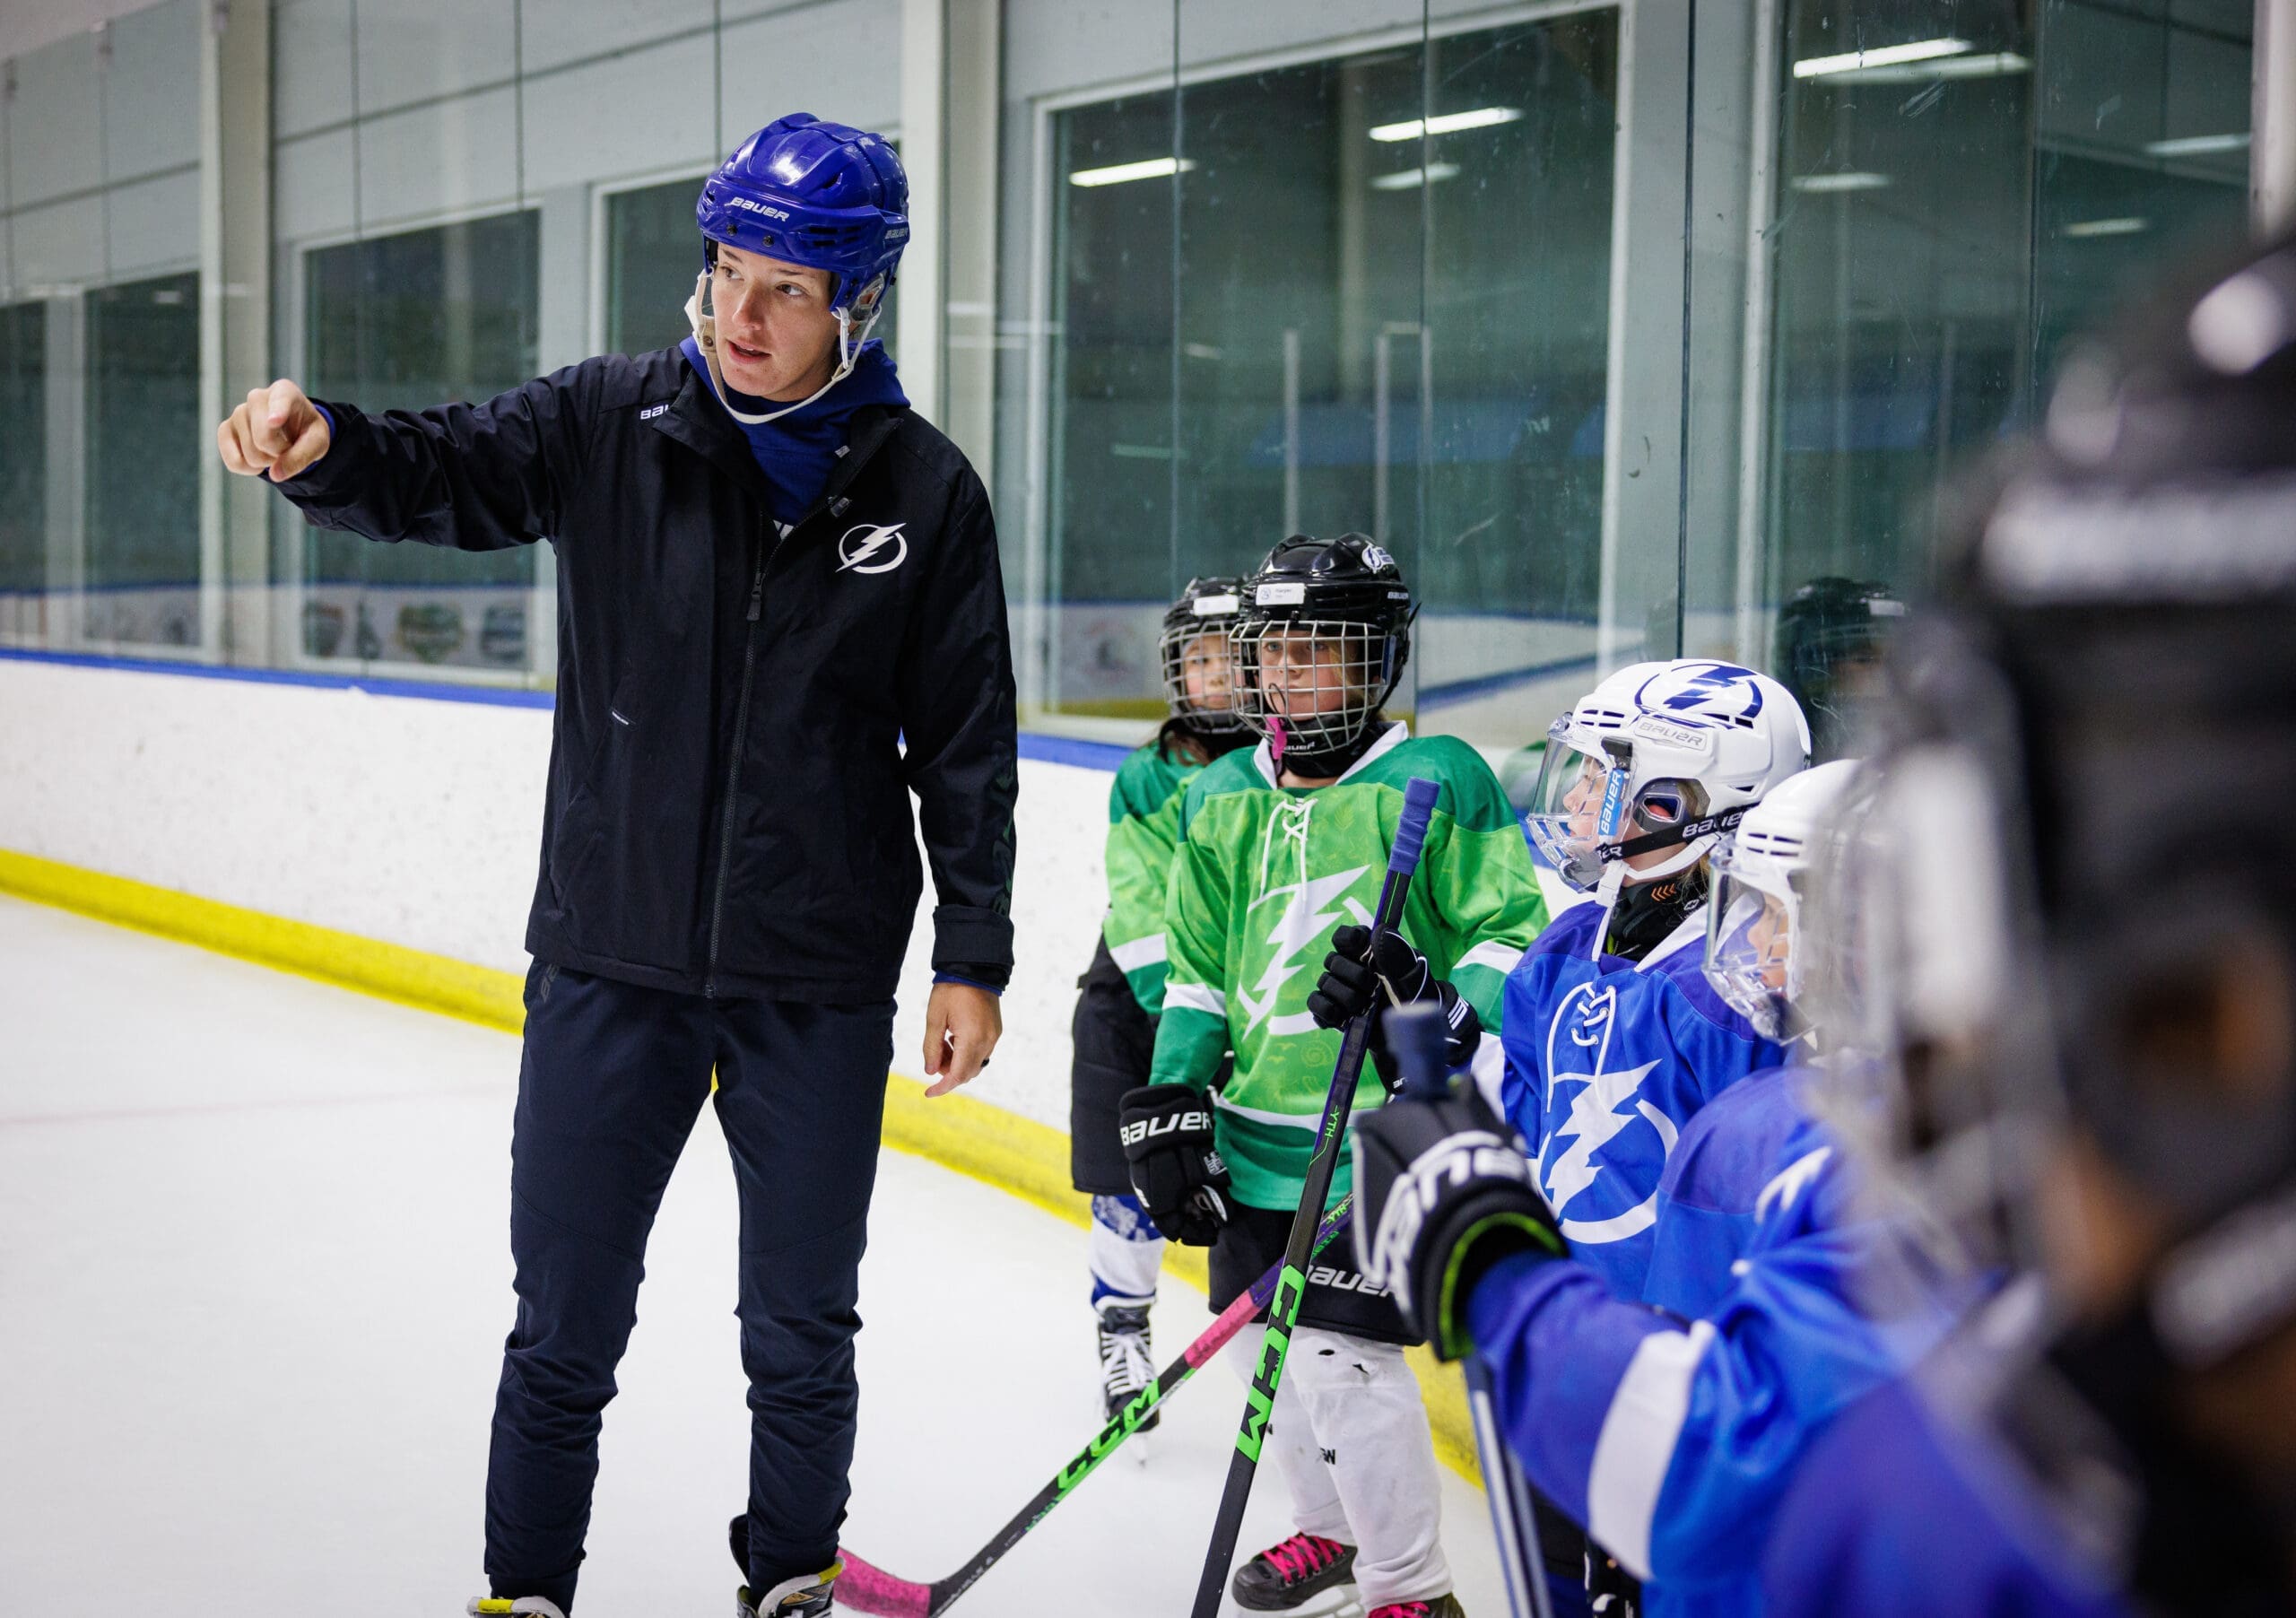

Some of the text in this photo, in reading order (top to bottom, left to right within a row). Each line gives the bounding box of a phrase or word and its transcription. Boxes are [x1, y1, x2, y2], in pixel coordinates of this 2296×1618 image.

[730, 196, 790, 222] BAUER
[1638, 720, 1704, 747] BAUER
[1600, 770, 1622, 835] BAUER
[1119, 1111, 1213, 1146] BAUER
[1235, 1264, 1306, 1464] CCM
[1057, 1378, 1160, 1489] CCM
